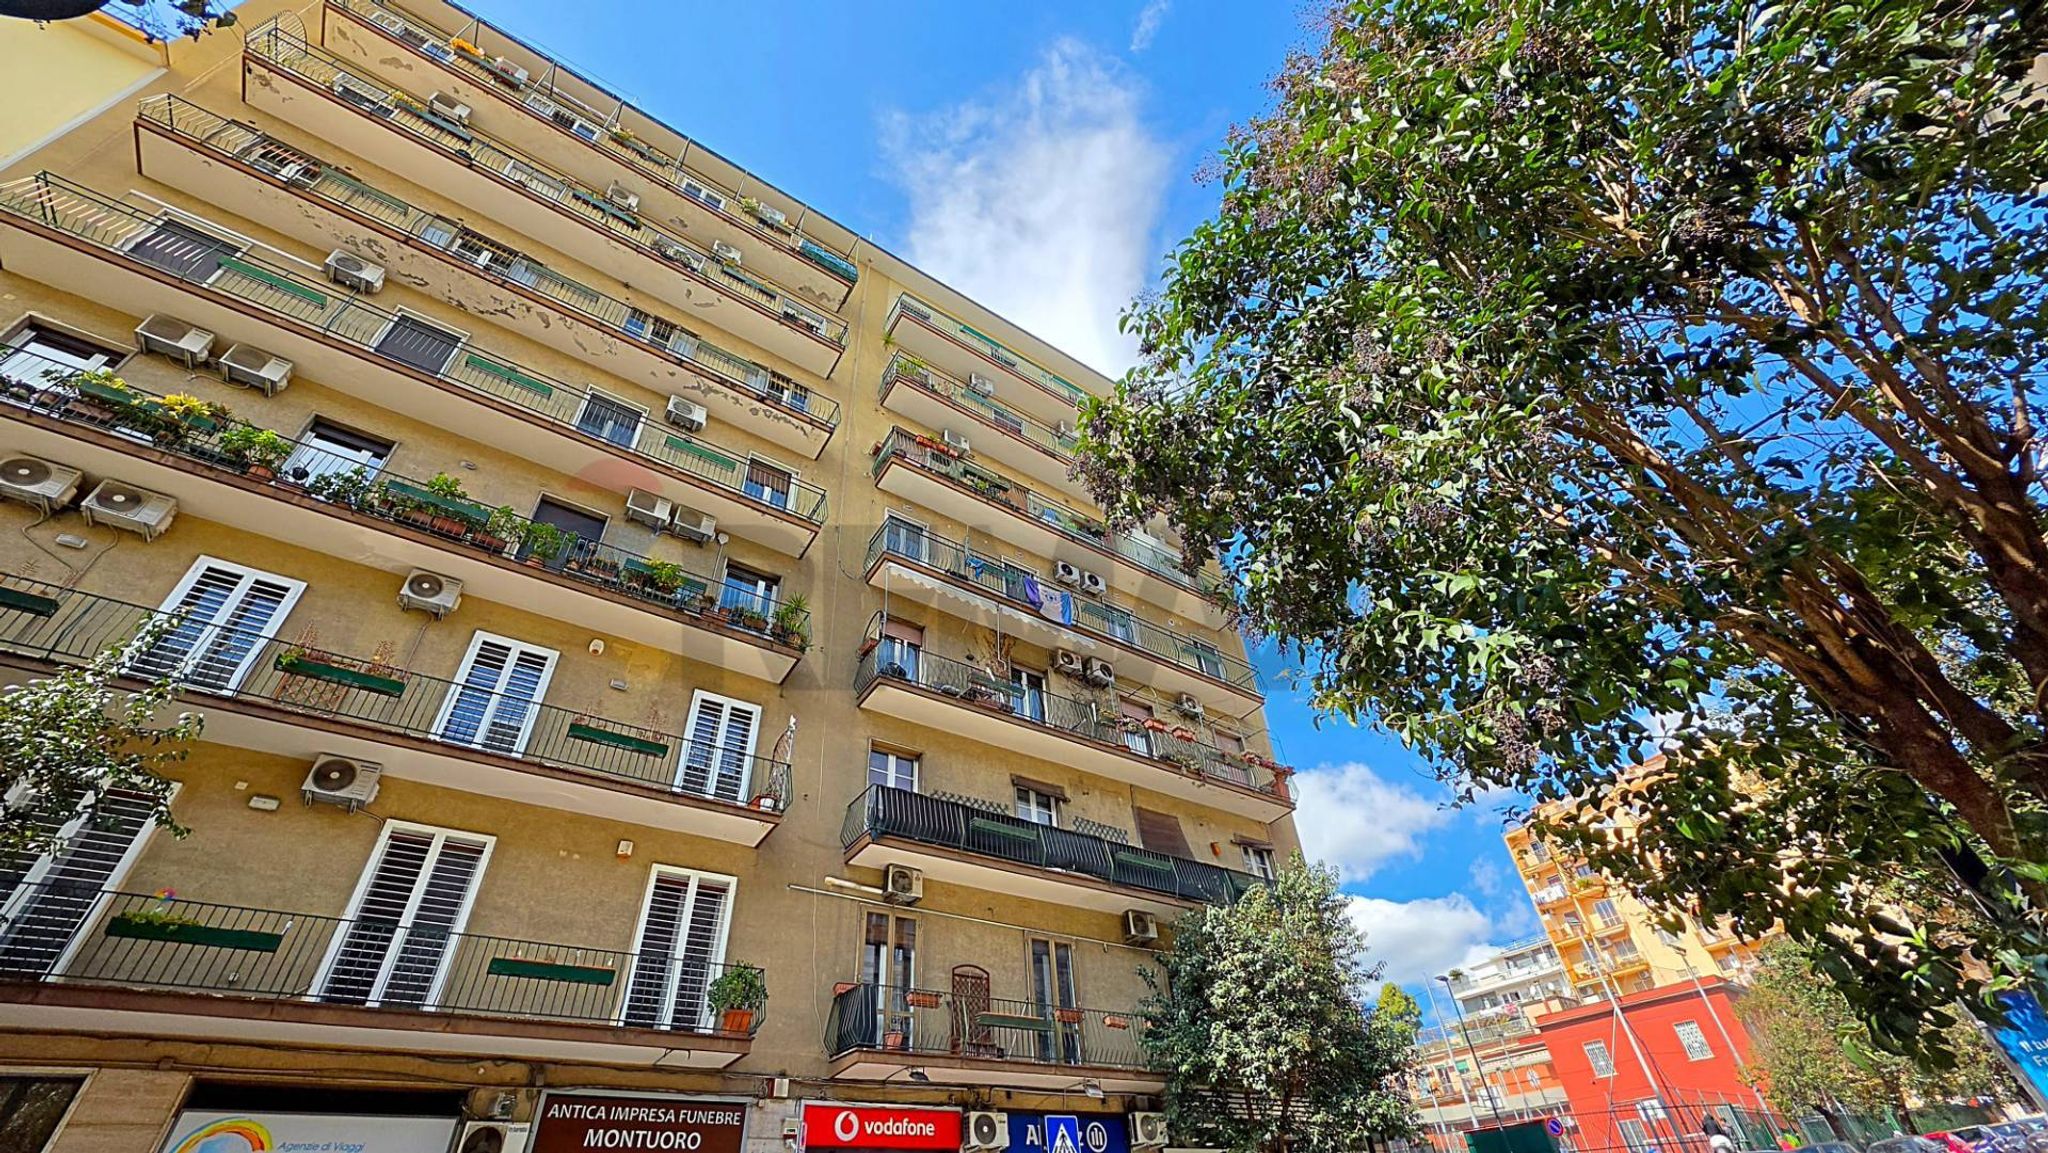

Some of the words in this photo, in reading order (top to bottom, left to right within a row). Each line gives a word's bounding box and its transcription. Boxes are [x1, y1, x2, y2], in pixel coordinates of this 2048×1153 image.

[547, 1103, 606, 1120] ANTICA
[609, 1106, 675, 1123] IMPRESA
[678, 1109, 741, 1125] FUNEBRE
[864, 1116, 935, 1136] vodafone
[321, 1142, 332, 1151] di
[334, 1142, 367, 1153] Viaggi
[583, 1128, 702, 1150] MONTUORO
